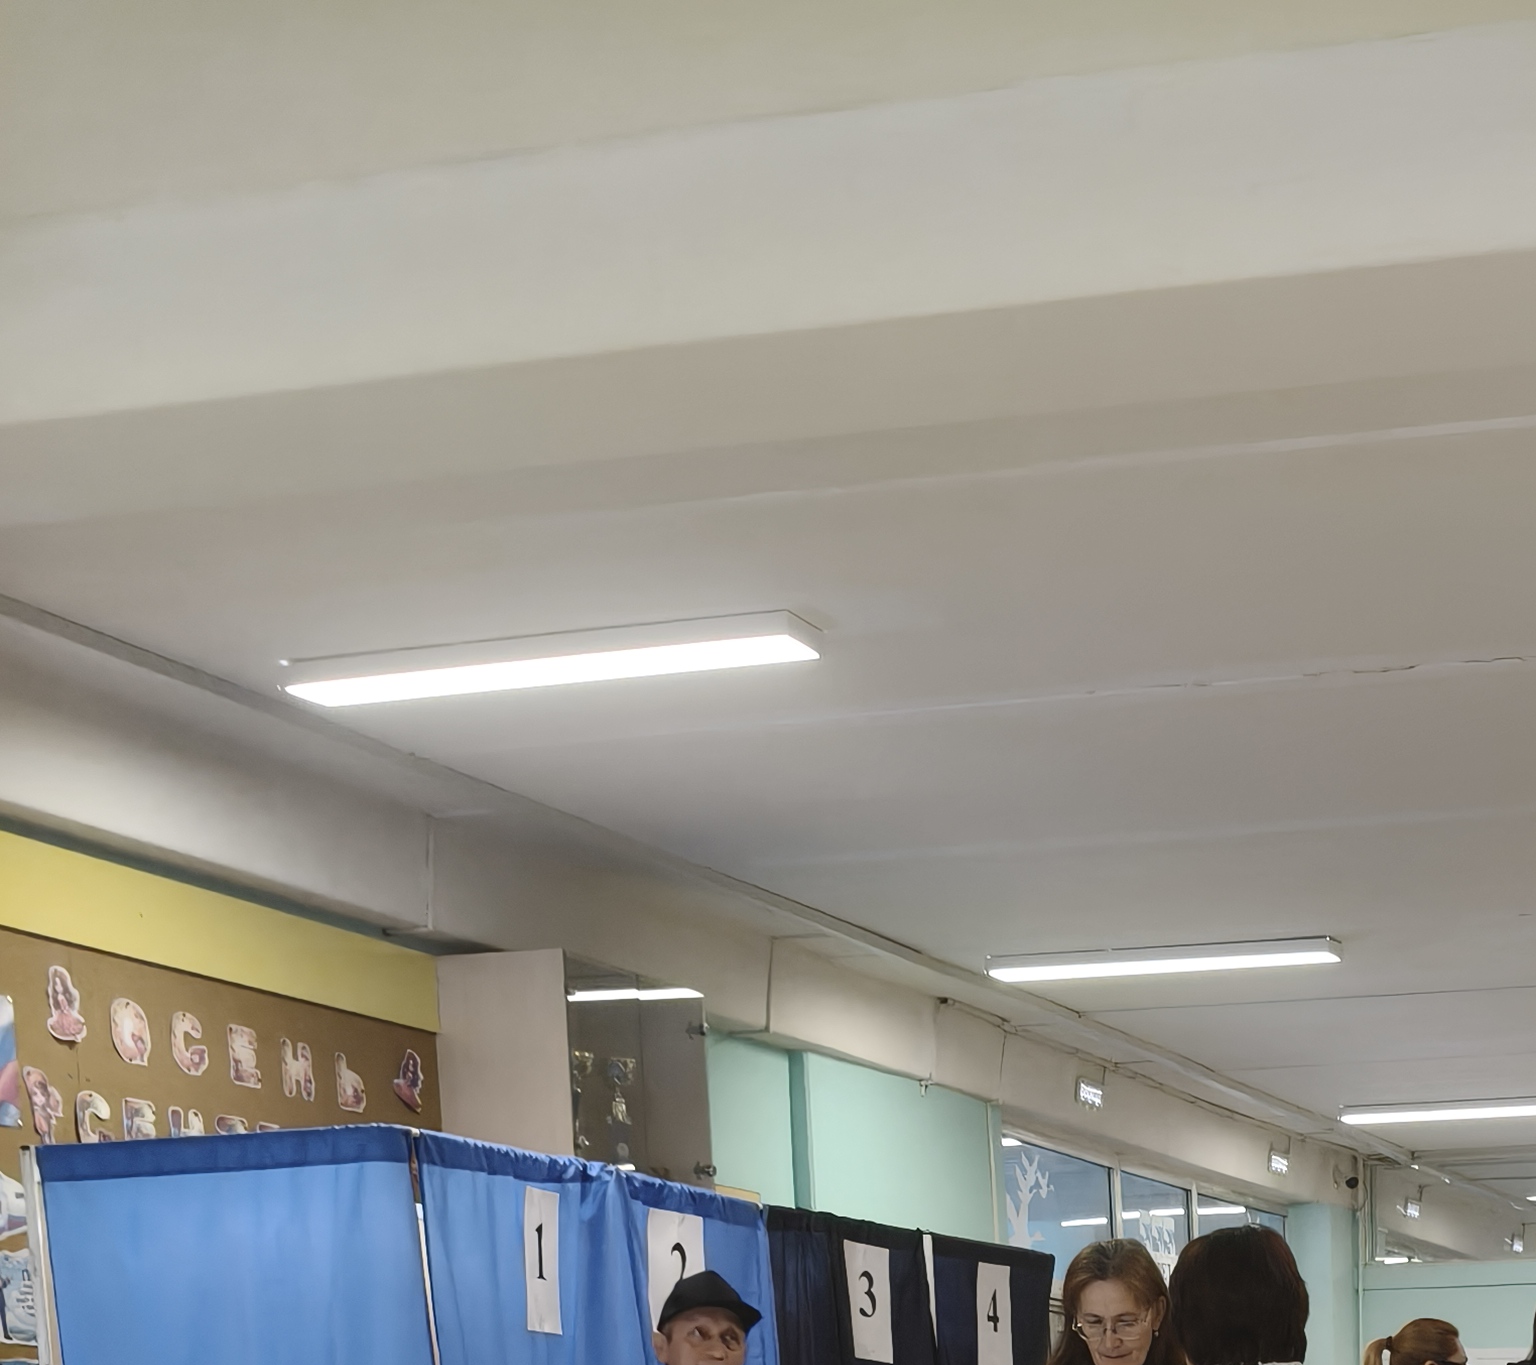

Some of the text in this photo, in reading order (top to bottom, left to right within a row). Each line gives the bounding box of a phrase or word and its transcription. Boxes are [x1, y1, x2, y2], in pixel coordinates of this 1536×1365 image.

[110, 997, 367, 1113] ОСЕНЬ
[535, 1222, 547, 1281] 1
[858, 1270, 877, 1319] 3
[986, 1288, 1000, 1333] 4
